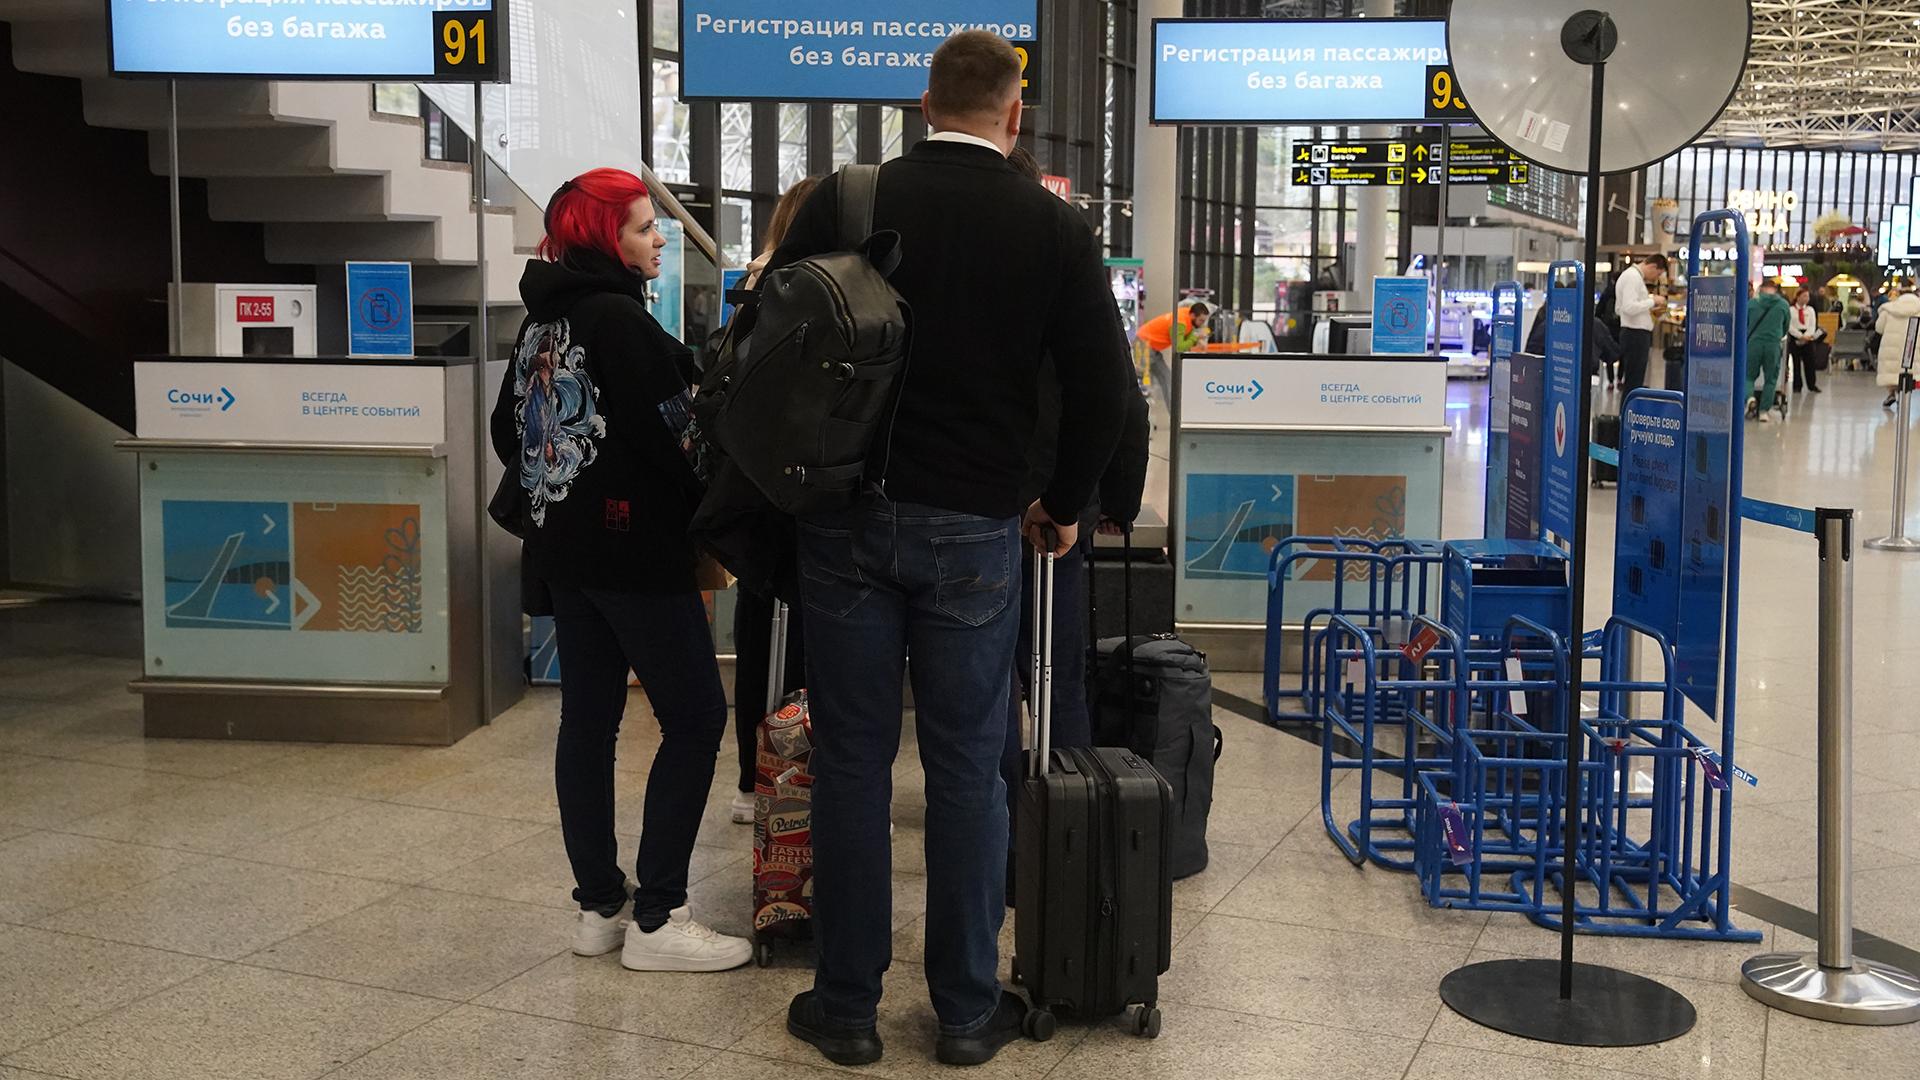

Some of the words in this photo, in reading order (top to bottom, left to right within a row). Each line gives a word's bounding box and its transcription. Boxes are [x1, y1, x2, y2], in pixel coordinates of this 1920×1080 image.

[227, 16, 274, 38] без
[282, 16, 387, 40] багажа
[696, 13, 864, 39] Регистрация
[443, 18, 486, 65] 91
[789, 46, 833, 66] без
[841, 46, 934, 67] багажа
[1162, 44, 1316, 66] Регистрация
[1323, 47, 1449, 66] пассажир
[1247, 71, 1287, 89] без
[1294, 71, 1383, 90] багажа
[1432, 71, 1467, 110] 9
[239, 302, 252, 317] ПК
[253, 302, 273, 317] 2-55
[1205, 381, 1245, 394] Сочи
[1320, 383, 1361, 393] ВСЕГДА
[168, 389, 213, 404] Сочи
[302, 391, 347, 403] ВСЕГДА
[1320, 395, 1327, 403] В
[1330, 395, 1369, 405] ЦЕНТРЕ
[1371, 394, 1422, 404] СОБЫТИЙ
[302, 405, 311, 415] В
[314, 405, 359, 417] ЦЕНТРЕ
[362, 404, 420, 417] СОБЫТИЙ
[1627, 409, 1661, 429] Проверьте
[1661, 417, 1681, 431] свою
[1630, 429, 1654, 446] ручную
[1654, 433, 1675, 448] кладь
[771, 846, 812, 857] EASTE
[771, 855, 812, 864] FREEW
